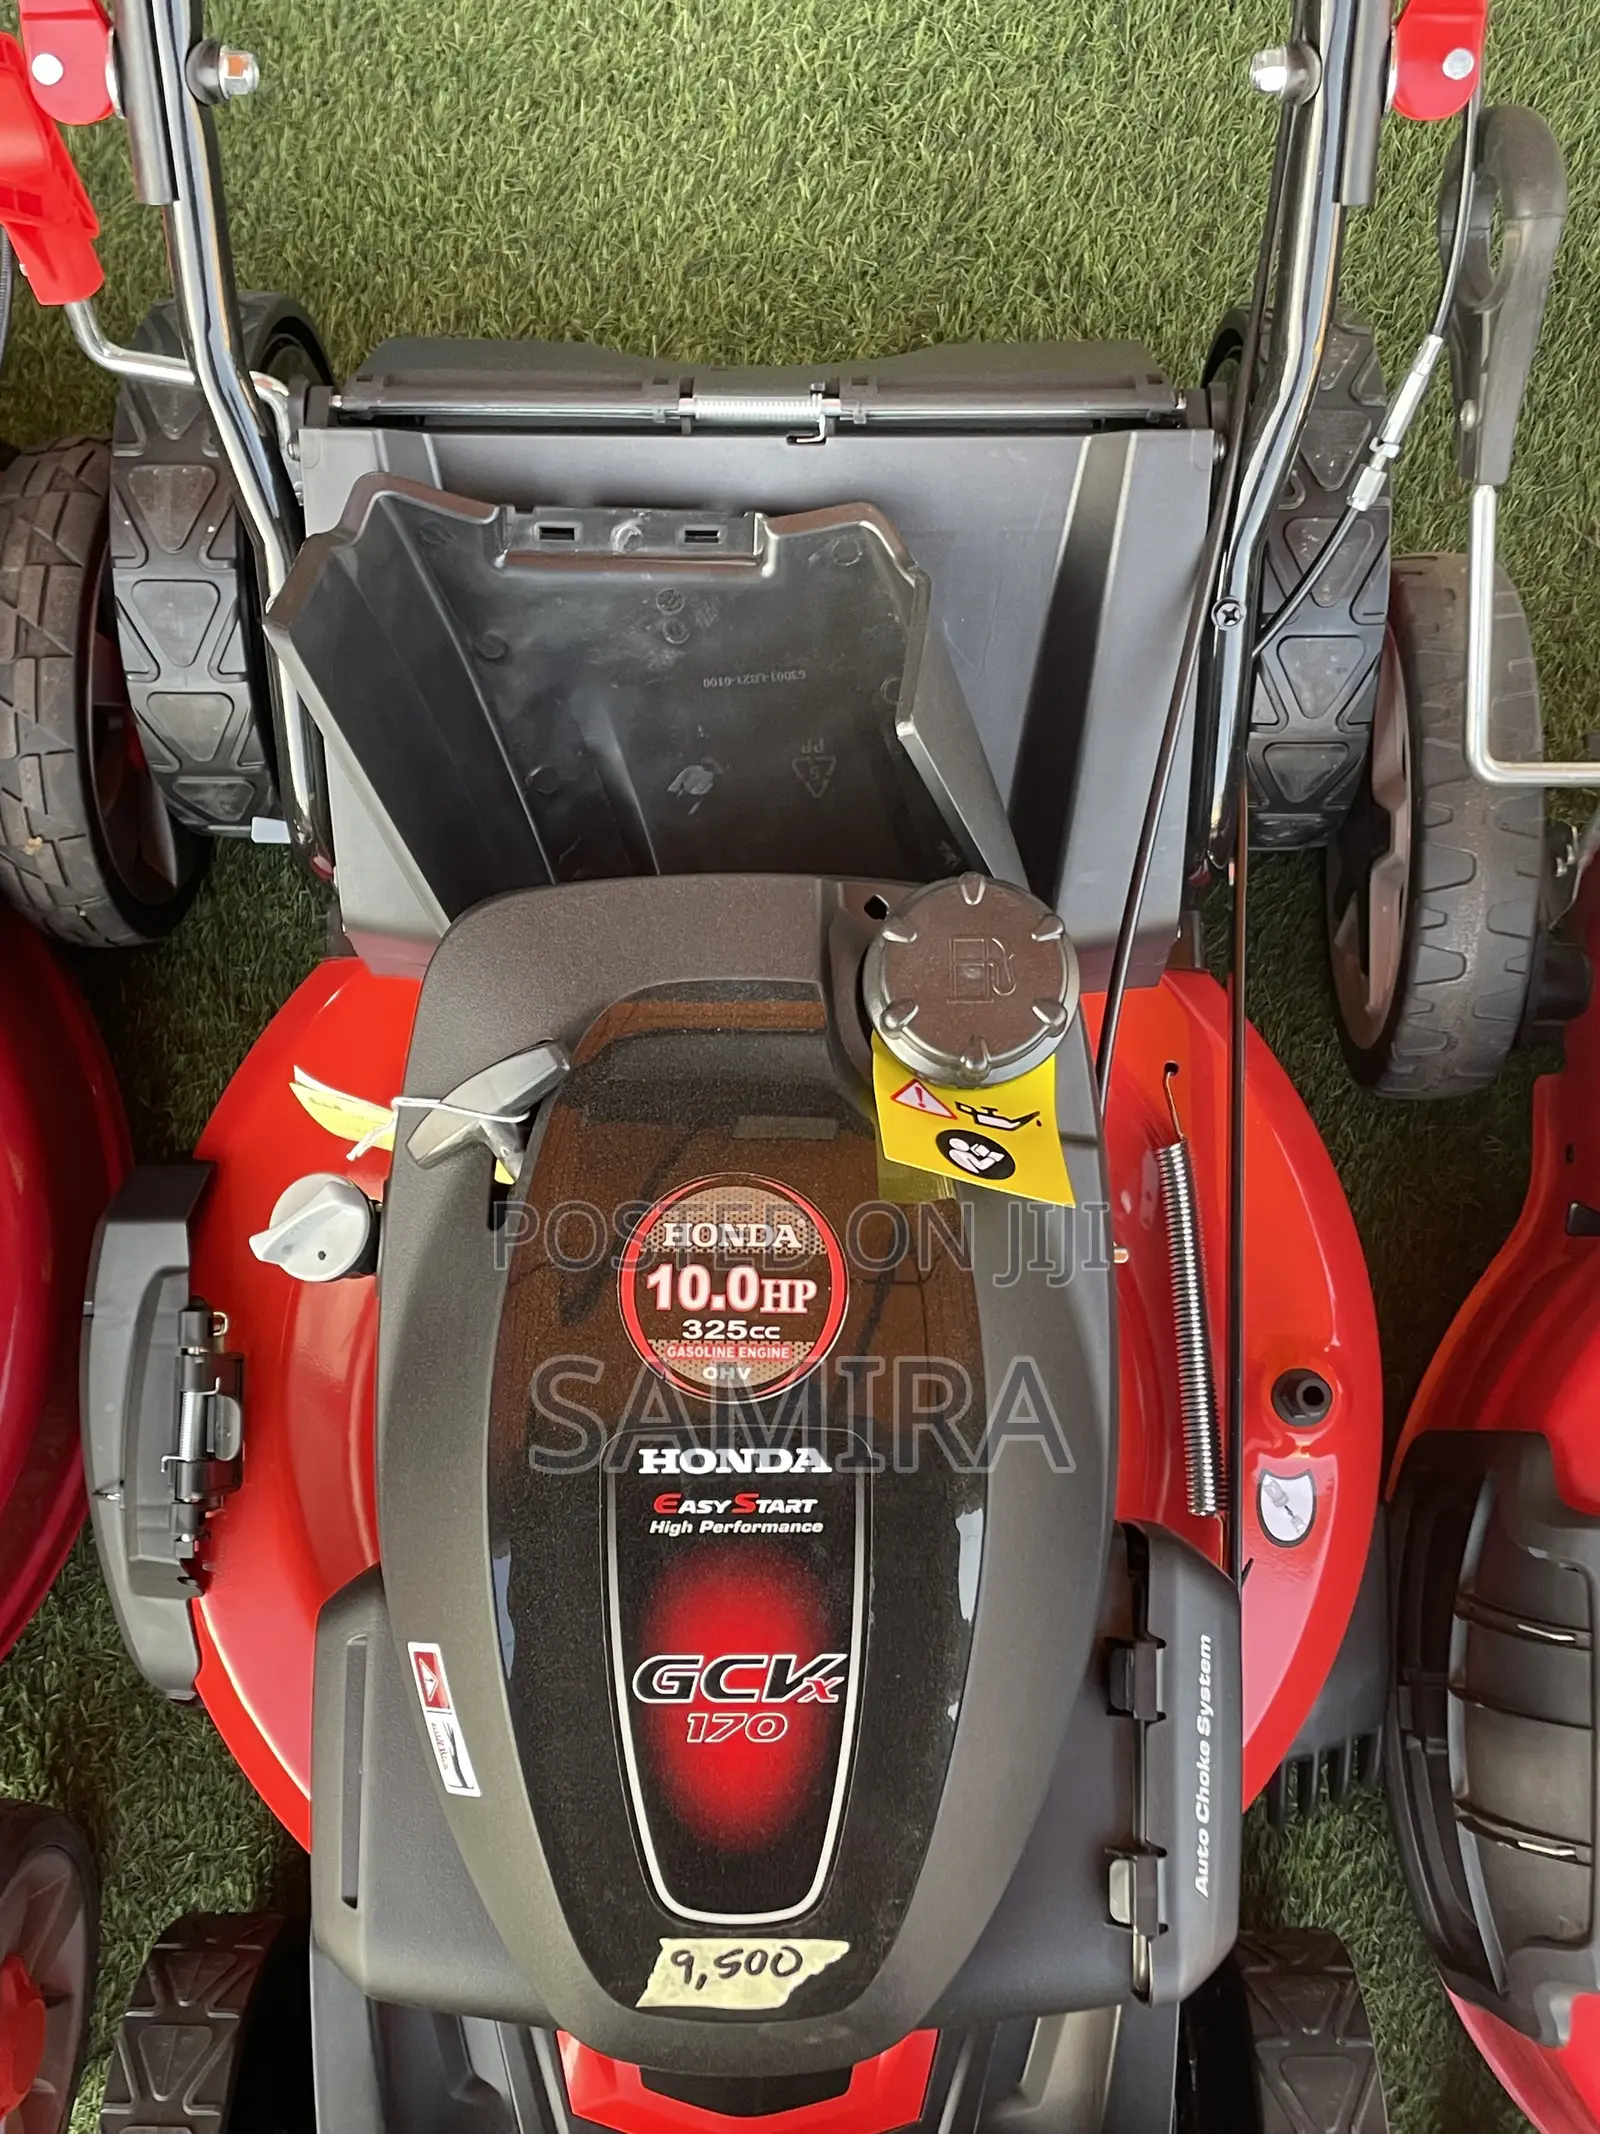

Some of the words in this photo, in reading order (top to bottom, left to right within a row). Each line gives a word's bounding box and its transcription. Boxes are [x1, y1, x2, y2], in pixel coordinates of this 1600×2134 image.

[662, 1221, 802, 1248] HONDA
[666, 1345, 736, 1359] GASOLINE
[738, 1346, 790, 1359] ENGINE
[702, 1366, 752, 1380] OHV
[638, 1447, 833, 1475] HONDA
[650, 1519, 693, 1537] High
[699, 1519, 824, 1534] Performance
[1196, 1633, 1215, 1738] System
[686, 1712, 789, 1743] 170
[1195, 1739, 1211, 1823] Choke
[1194, 1828, 1210, 1898] Auto
[670, 1948, 804, 1991] 9,500
